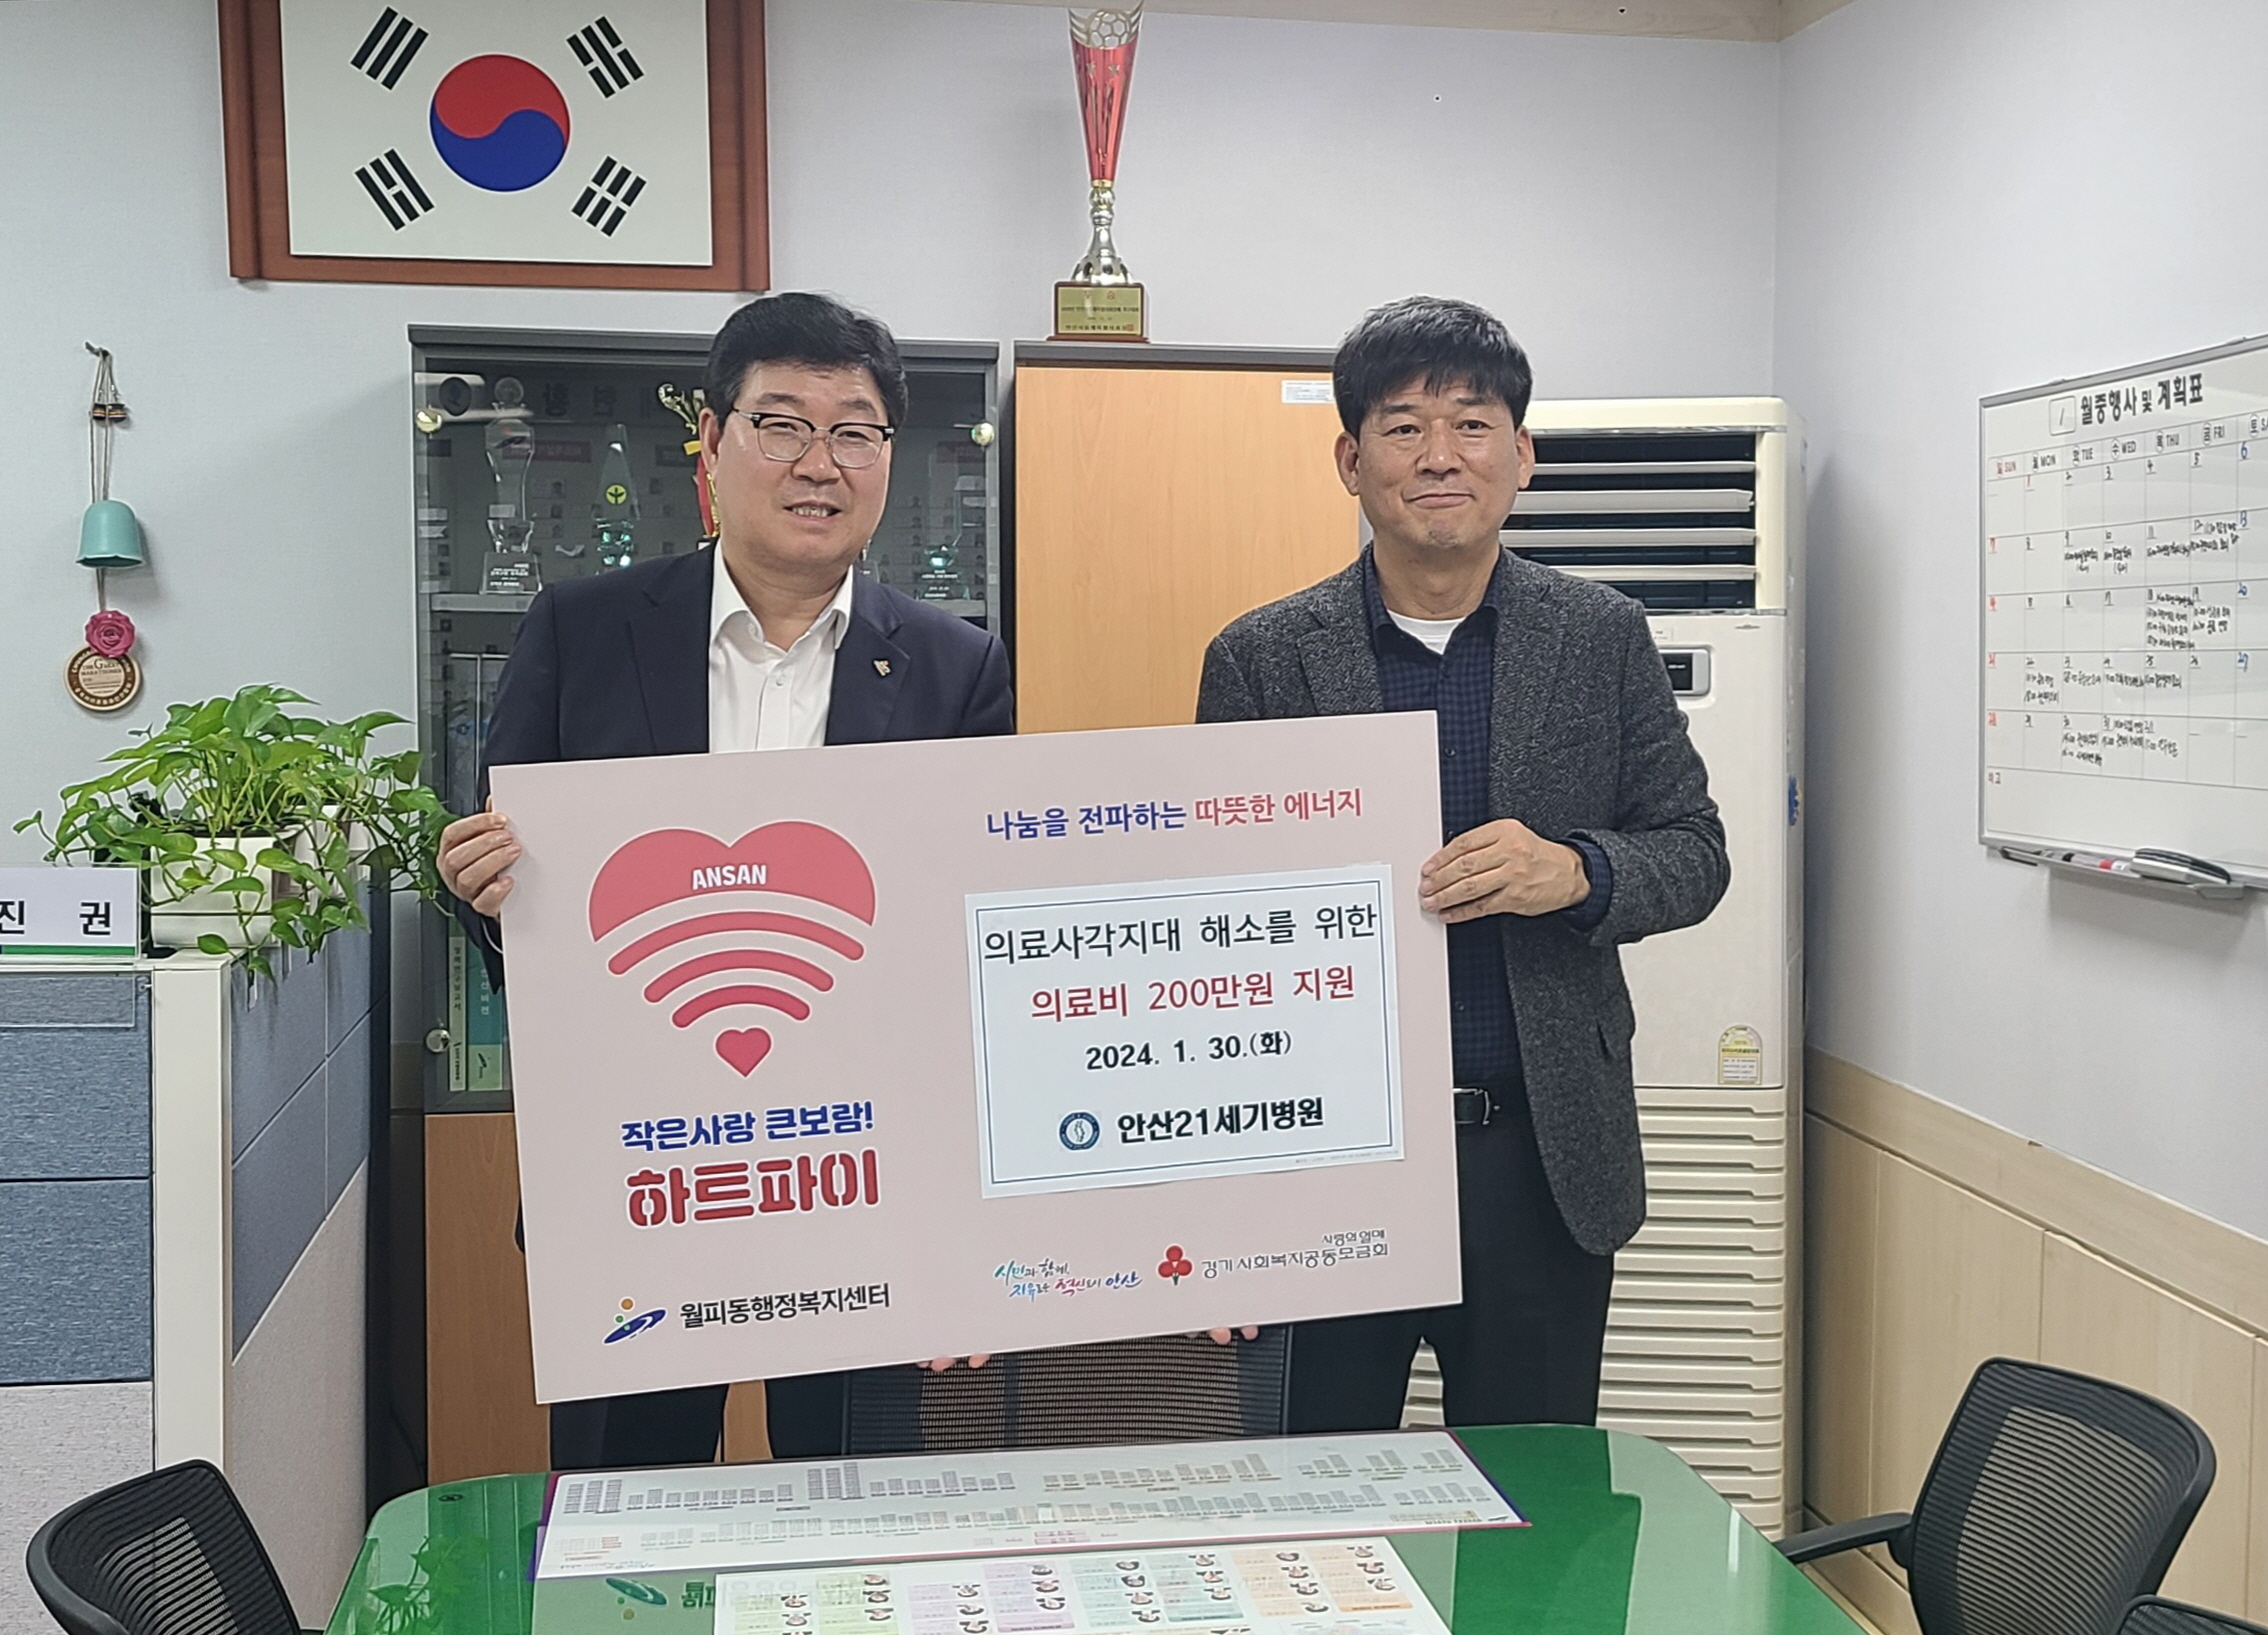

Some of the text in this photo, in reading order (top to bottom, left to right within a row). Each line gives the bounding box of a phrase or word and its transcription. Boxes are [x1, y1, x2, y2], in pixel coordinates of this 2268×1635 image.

[2081, 372, 2204, 426] 월중행사 및 계획표
[2122, 440, 2137, 454] WED
[2166, 433, 2180, 447] THU
[2213, 425, 2225, 439] FRI
[2004, 461, 2017, 473] SUN
[2040, 454, 2056, 467] MON
[2081, 447, 2094, 461] TUE
[987, 788, 1362, 841] 나눔을 전파하는 따뜻한 에너지
[692, 864, 767, 890] ANSAN
[79, 901, 111, 936] 권
[983, 903, 1378, 965] 의료사각지대 해소를 위한
[1030, 965, 1355, 1023] 의료비 200만원 지원
[1085, 1030, 1292, 1071] 2024. 1. 30.(화)
[621, 1100, 873, 1151] 작은사랑 큰보람!
[1117, 1097, 1325, 1144] 안산21세기병원
[626, 1149, 879, 1227] 하트파이
[994, 1259, 1039, 1287] 시민과
[1105, 1270, 1143, 1290] 안산
[679, 1282, 890, 1329] 월피동행정복지센터
